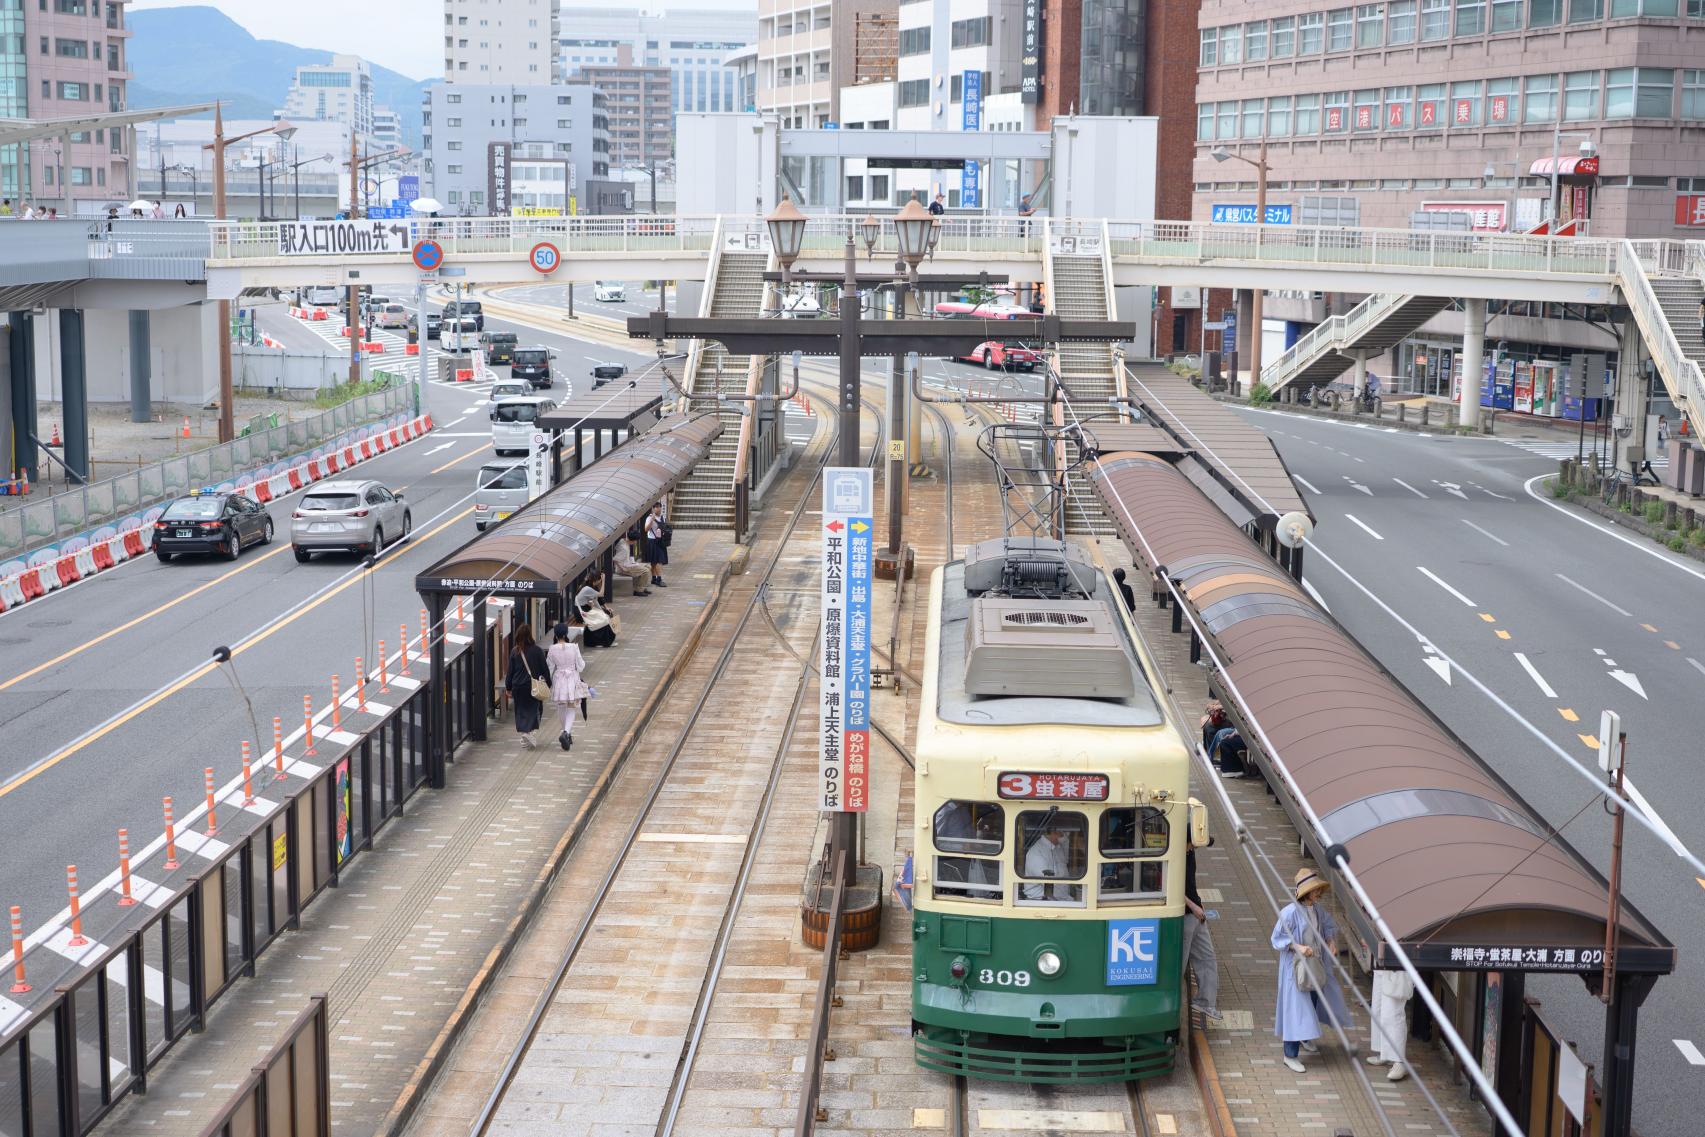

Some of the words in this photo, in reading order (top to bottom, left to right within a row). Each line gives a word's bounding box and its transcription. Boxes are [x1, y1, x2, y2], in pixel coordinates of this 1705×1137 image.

[1022, 77, 1036, 87] APA
[1329, 100, 1505, 129] 空港バス乗場
[279, 221, 389, 253] 駅入口100m先
[536, 250, 554, 265] 50
[517, 581, 534, 589] のりば
[825, 537, 842, 761] 平和公園・原爆資料館・浦上天主堂
[849, 701, 864, 725] のりば
[849, 733, 864, 774] めがね橋
[824, 767, 839, 807] のりば
[848, 777, 864, 808] のりば
[1001, 773, 1032, 796] 3
[1035, 780, 1106, 798] 蛍茶屋
[1111, 926, 1155, 963] KE
[1553, 949, 1575, 963] 方面
[979, 968, 1031, 987] 309
